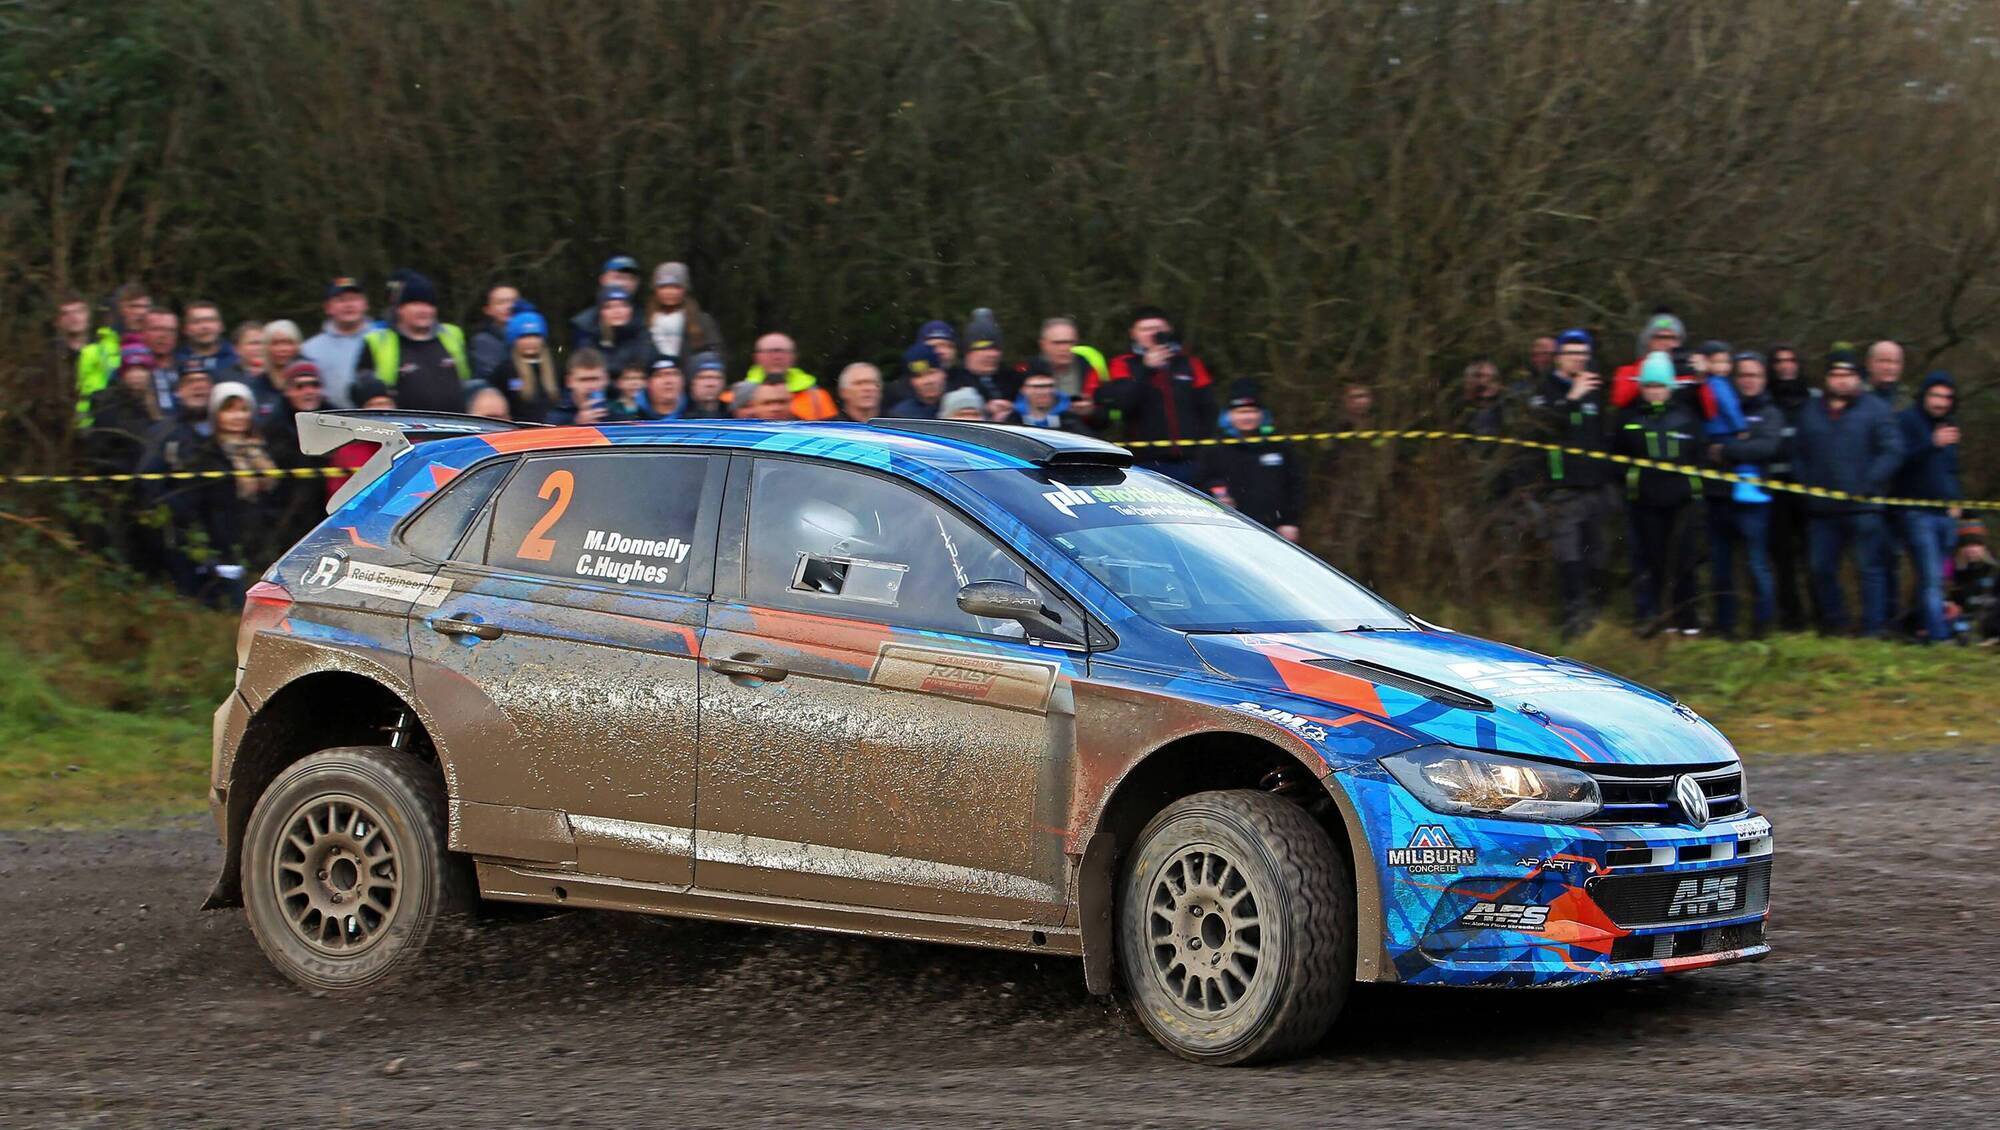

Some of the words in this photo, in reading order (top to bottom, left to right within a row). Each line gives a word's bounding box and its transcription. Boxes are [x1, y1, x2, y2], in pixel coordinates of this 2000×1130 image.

[516, 470, 575, 561] 2
[583, 530, 691, 563] M.Donnelly
[351, 568, 376, 581] Reid
[376, 572, 440, 595] Engineering
[575, 554, 669, 584] C.Hughes
[1388, 850, 1475, 865] MILBURN
[1408, 865, 1457, 873] CONCRETE
[1516, 858, 1539, 867] AP
[1542, 860, 1575, 870] ART
[1668, 877, 1739, 917] AFS
[1462, 902, 1550, 925] AFS
